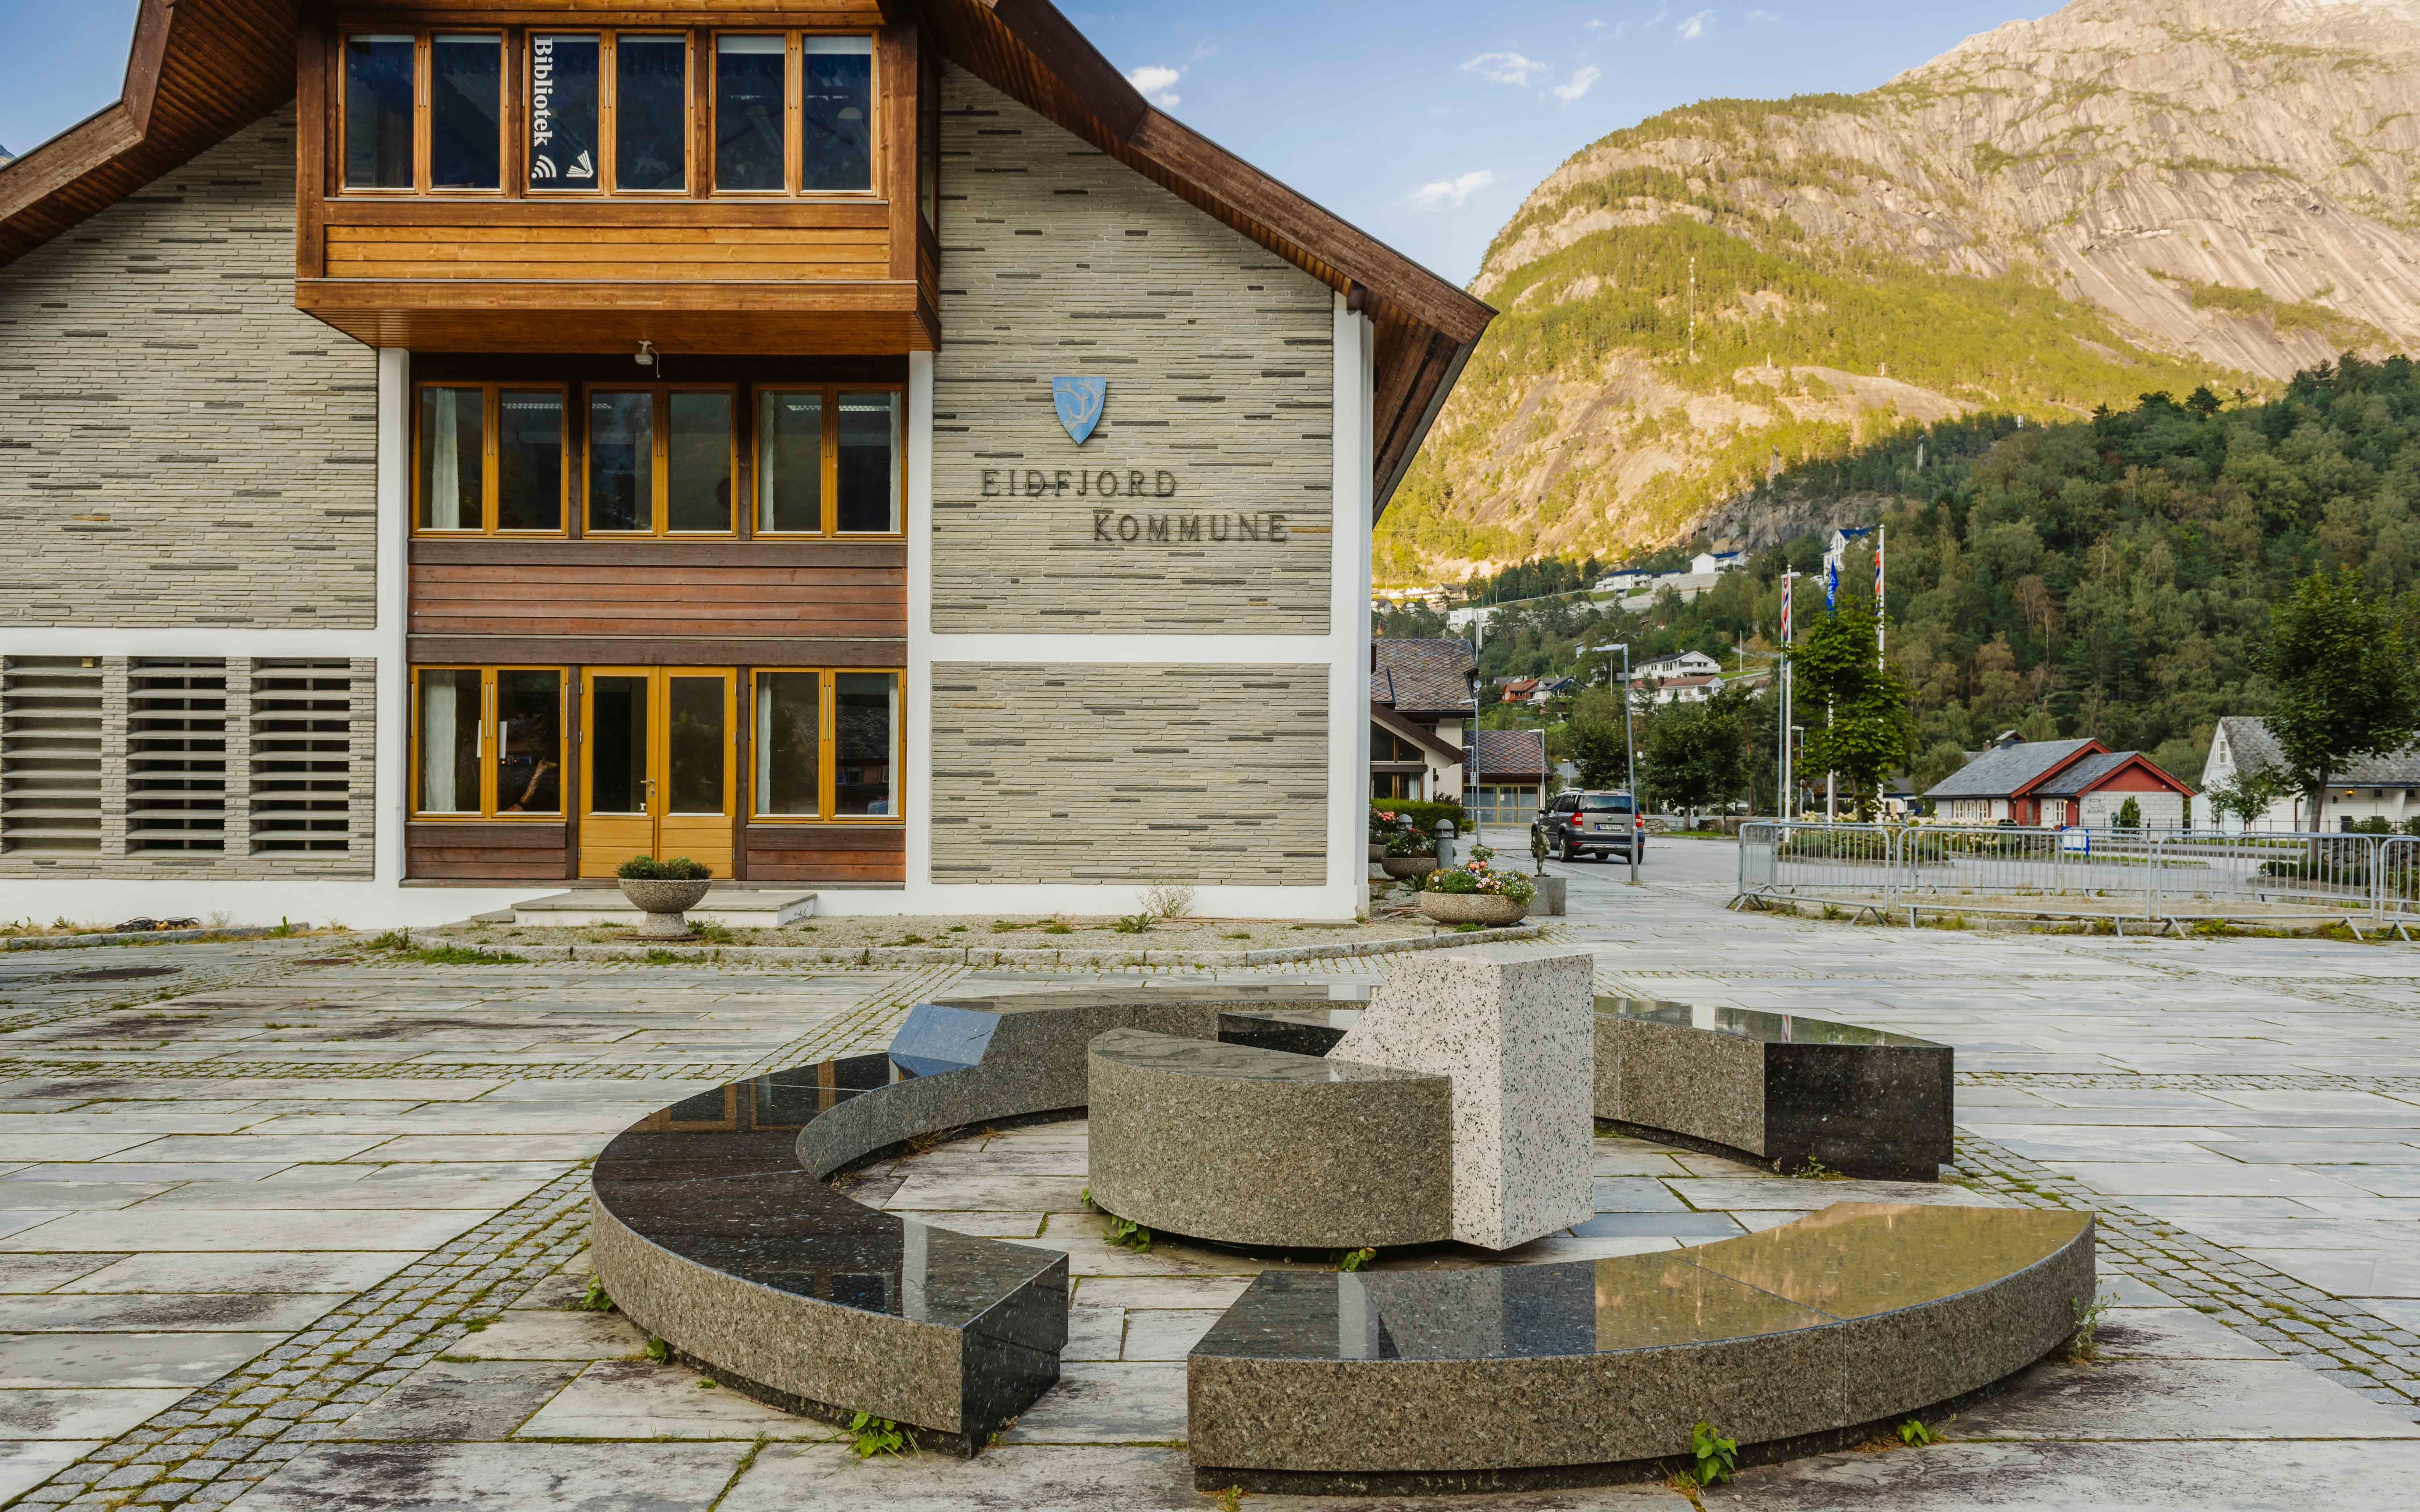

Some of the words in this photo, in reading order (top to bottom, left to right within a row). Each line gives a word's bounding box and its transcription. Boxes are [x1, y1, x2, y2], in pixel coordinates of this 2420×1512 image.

[534, 37, 553, 147] Bibliotek
[981, 469, 1175, 496] EIDFJORD
[1093, 514, 1286, 541] KOMMUNE
